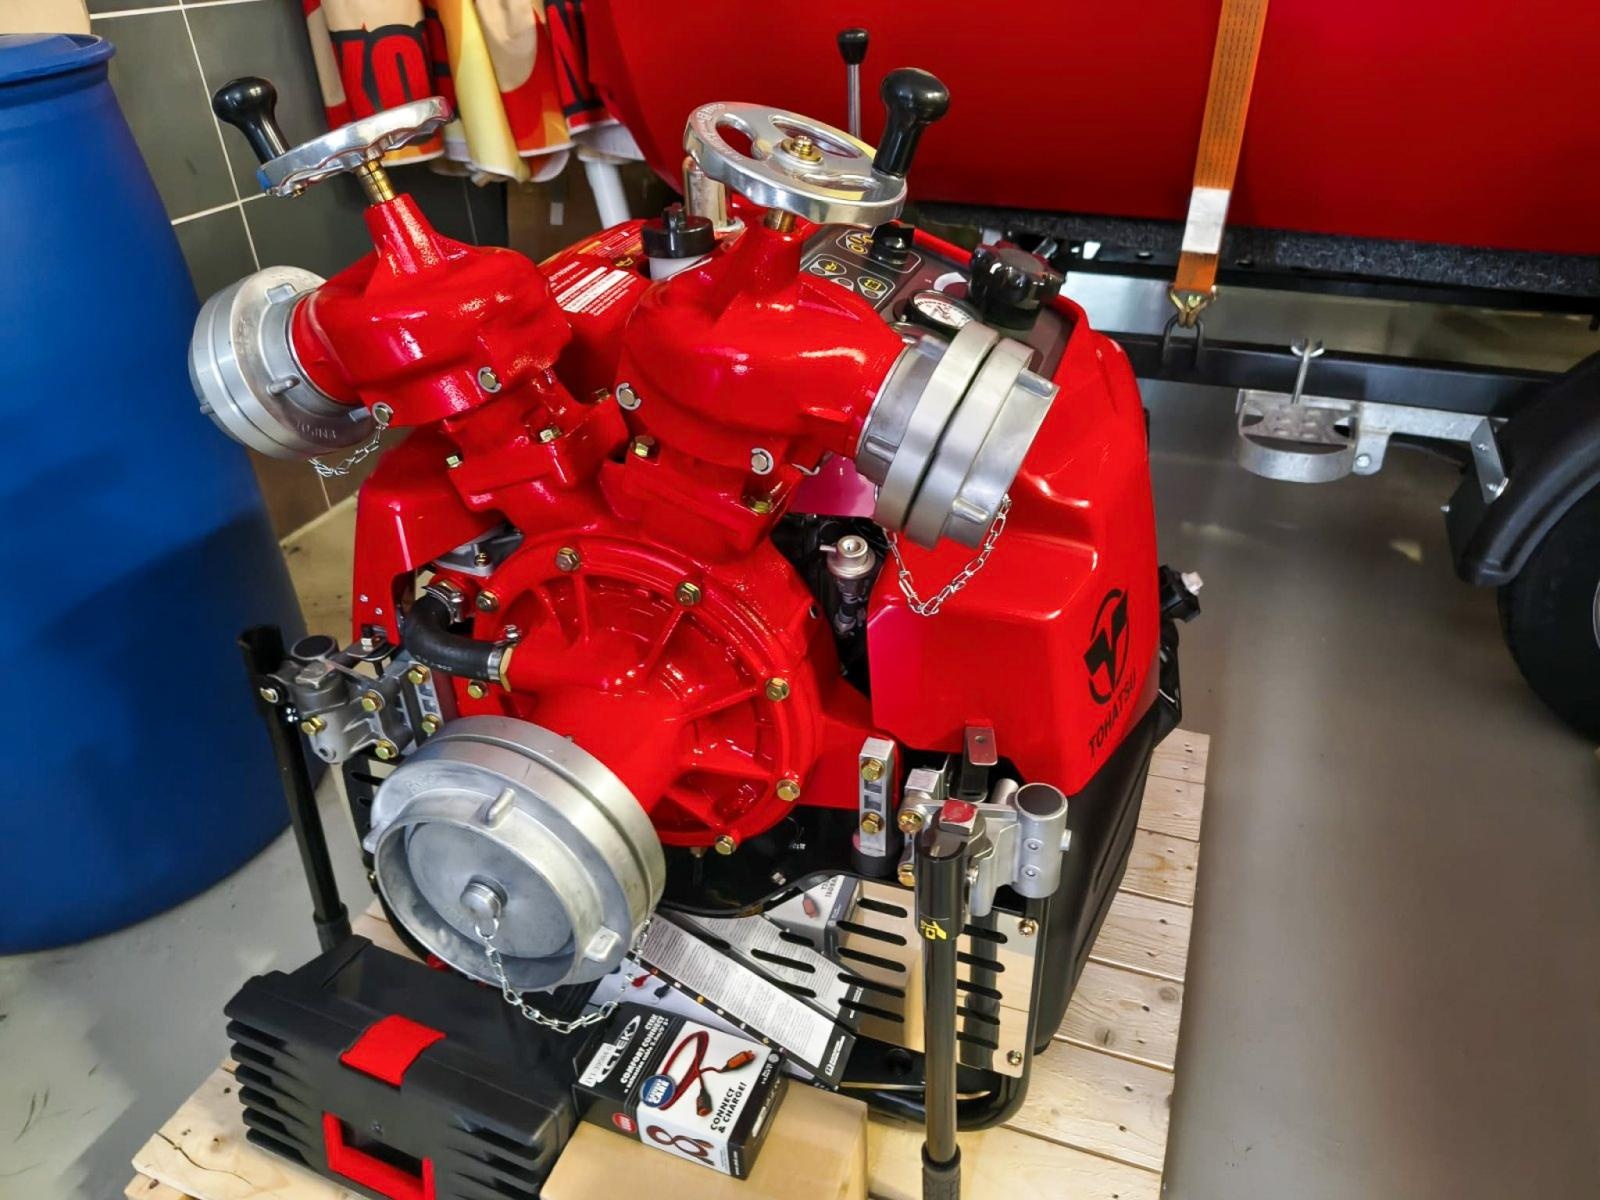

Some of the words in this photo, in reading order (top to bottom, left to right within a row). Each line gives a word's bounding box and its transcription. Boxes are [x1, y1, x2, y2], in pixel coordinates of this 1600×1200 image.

[1088, 670, 1137, 757] TOHATSU
[620, 1047, 646, 1084] COMFORT
[641, 1015, 665, 1048] CONNECT
[710, 1087, 735, 1131] CONNECT
[717, 1125, 726, 1134] &
[722, 1081, 748, 1123] CHARGE!
